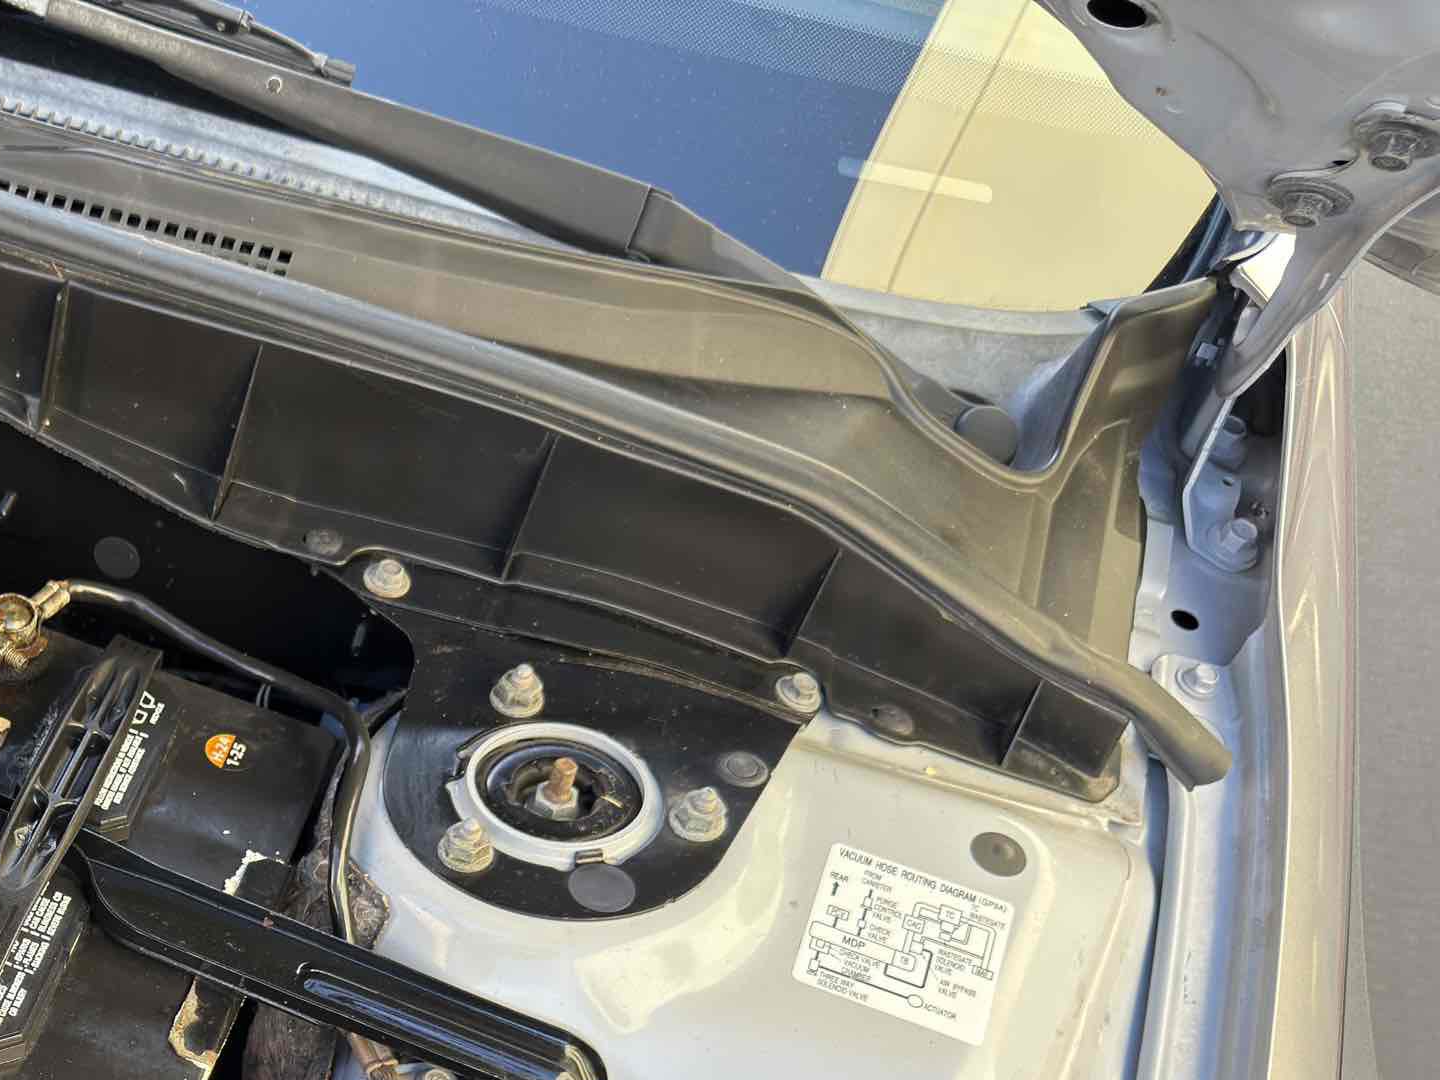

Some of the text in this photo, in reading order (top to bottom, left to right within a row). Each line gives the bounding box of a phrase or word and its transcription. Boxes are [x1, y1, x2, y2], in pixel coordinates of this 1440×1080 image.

[226, 741, 247, 766] 1-25
[838, 847, 872, 866] VACUUM
[874, 860, 898, 875] HOSE
[900, 869, 937, 890] ROUTING
[939, 882, 976, 903] DIAGRAM
